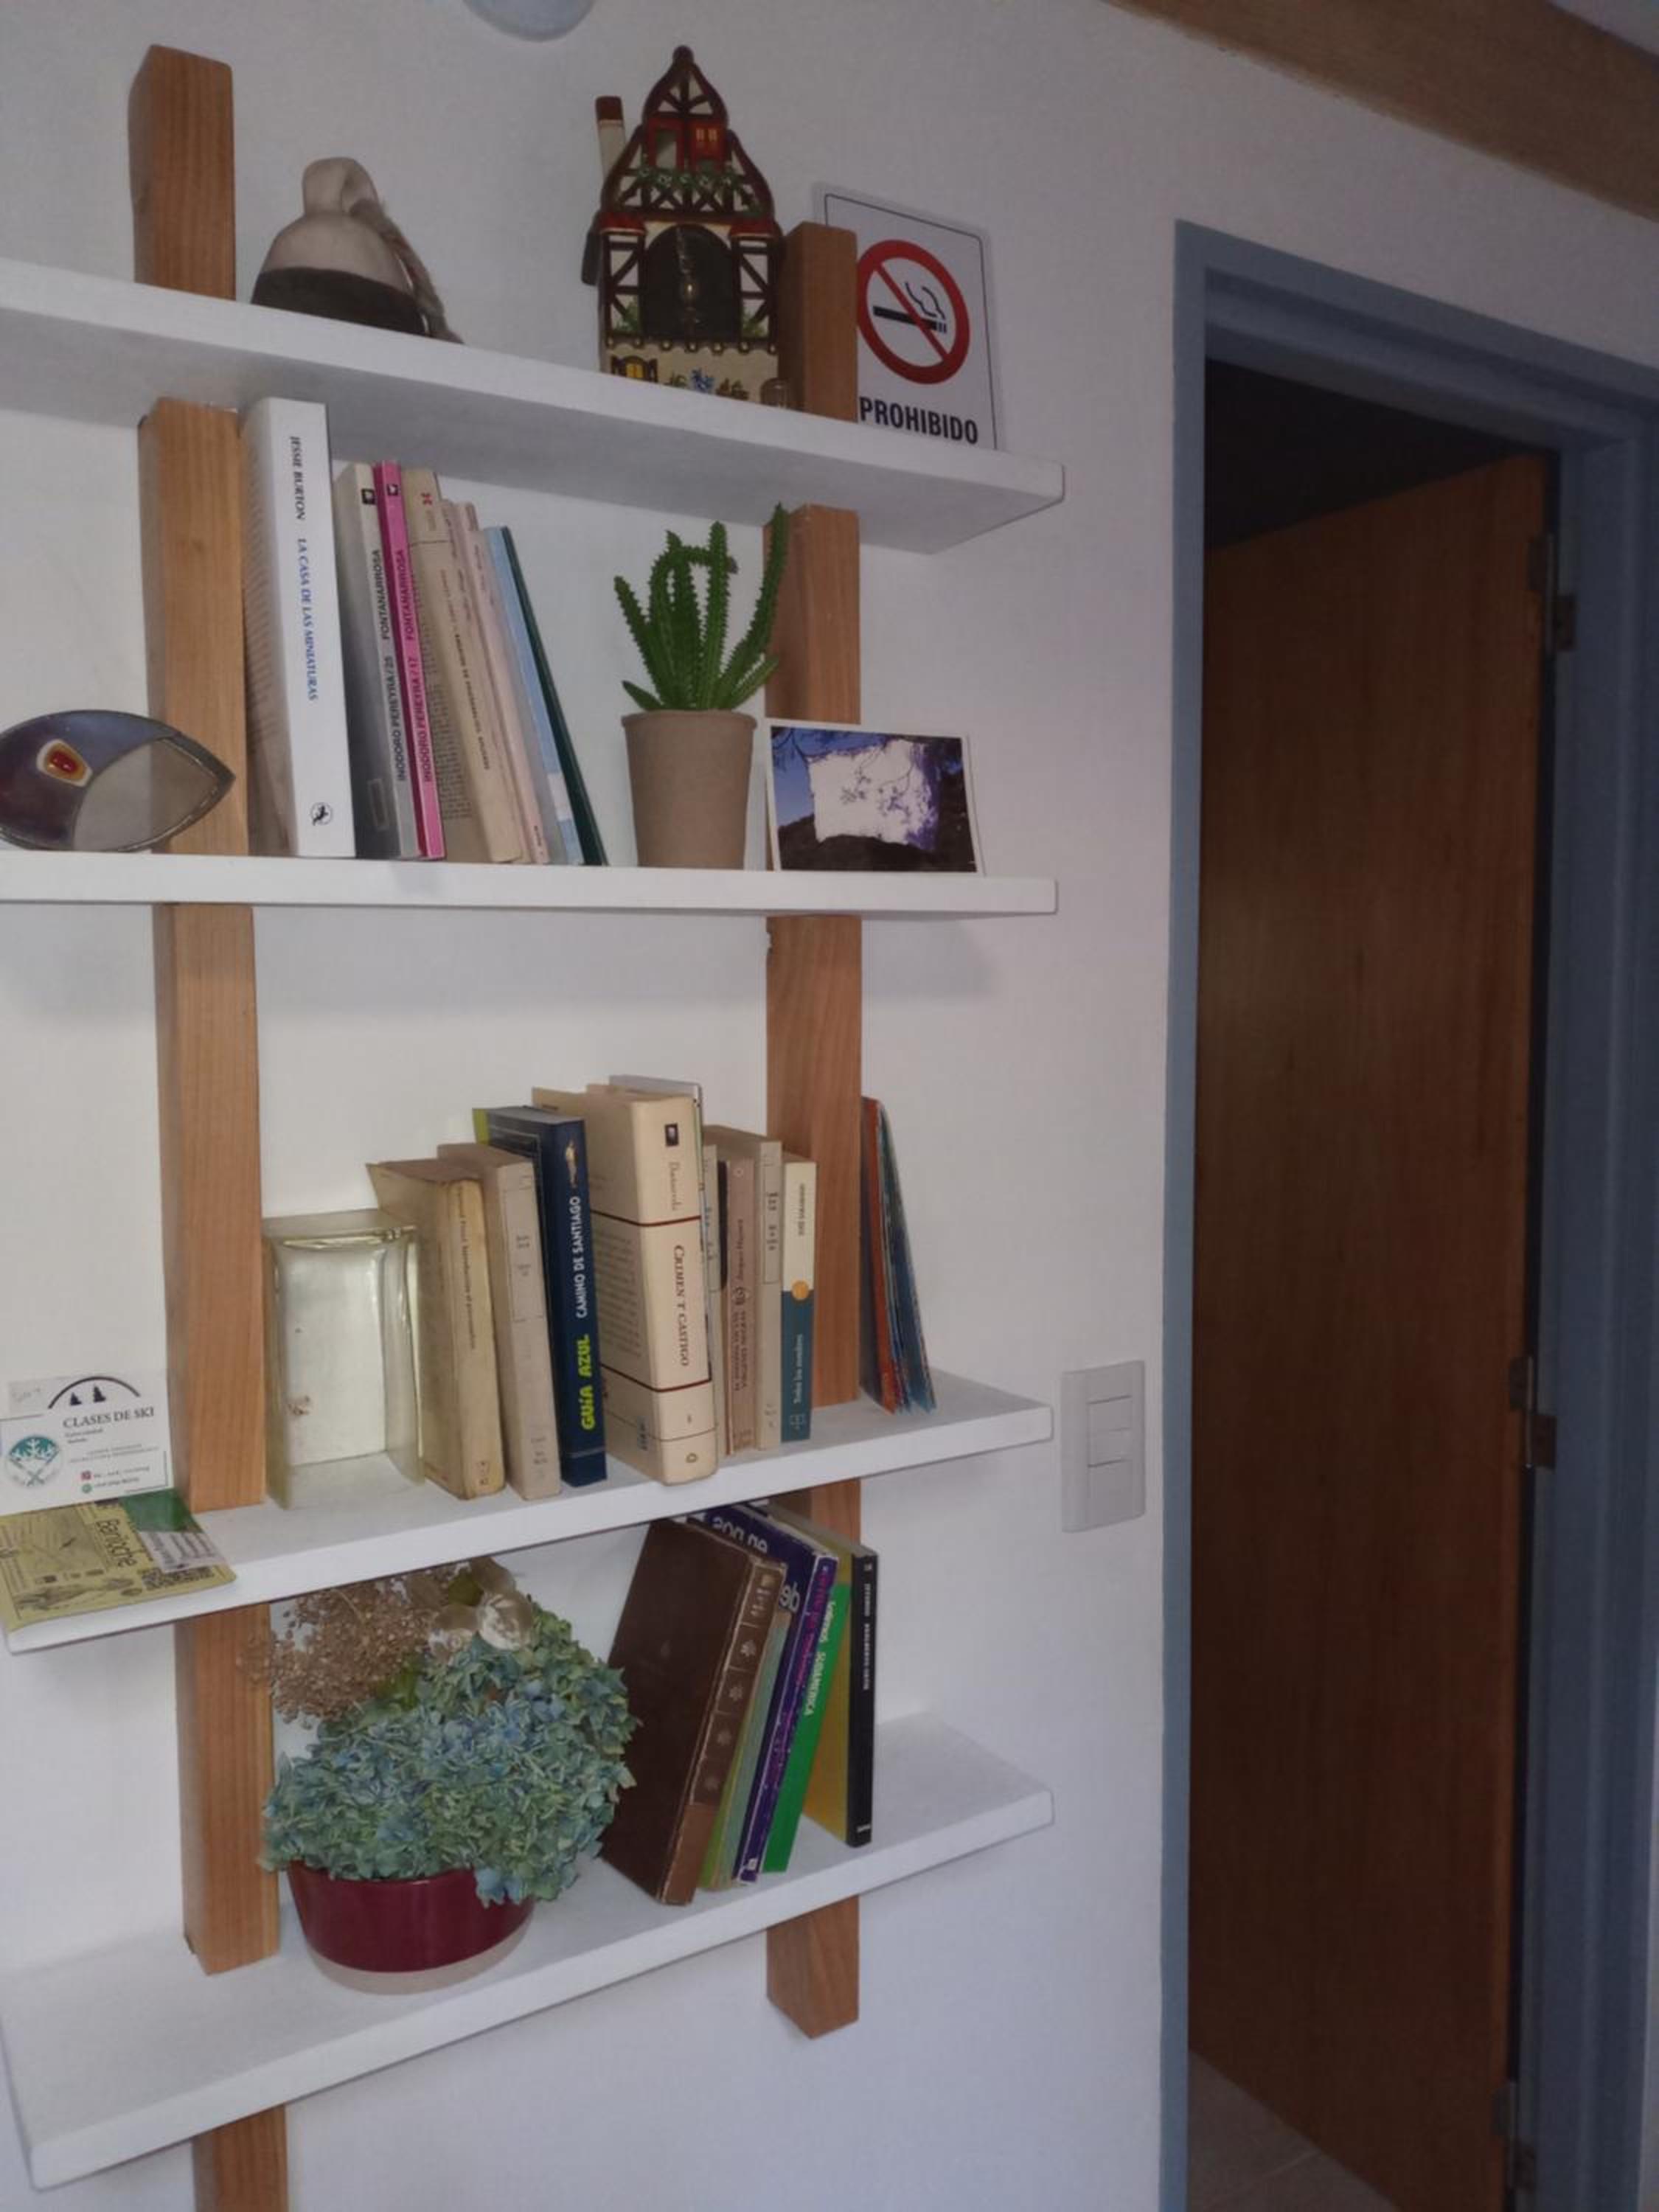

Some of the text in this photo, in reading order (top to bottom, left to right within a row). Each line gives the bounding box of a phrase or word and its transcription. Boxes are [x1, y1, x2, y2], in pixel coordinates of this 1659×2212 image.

[860, 396, 978, 445] PROHIBIDO
[290, 436, 305, 521] JESSIE BURTON
[298, 538, 319, 701] LA CASA DE LAS MINIATURAS
[372, 549, 391, 640] FONTANARROSA
[396, 550, 415, 641] FONTANARROSA
[391, 730, 406, 782] INODORO
[416, 731, 432, 782] INODORO
[569, 1196, 588, 1318] CAMINO DE SANTIAGO
[673, 1245, 689, 1367] CRIMEN Y CASTIGO
[577, 1334, 592, 1377] AZUL
[63, 1407, 154, 1428] CLASES DE SKI
